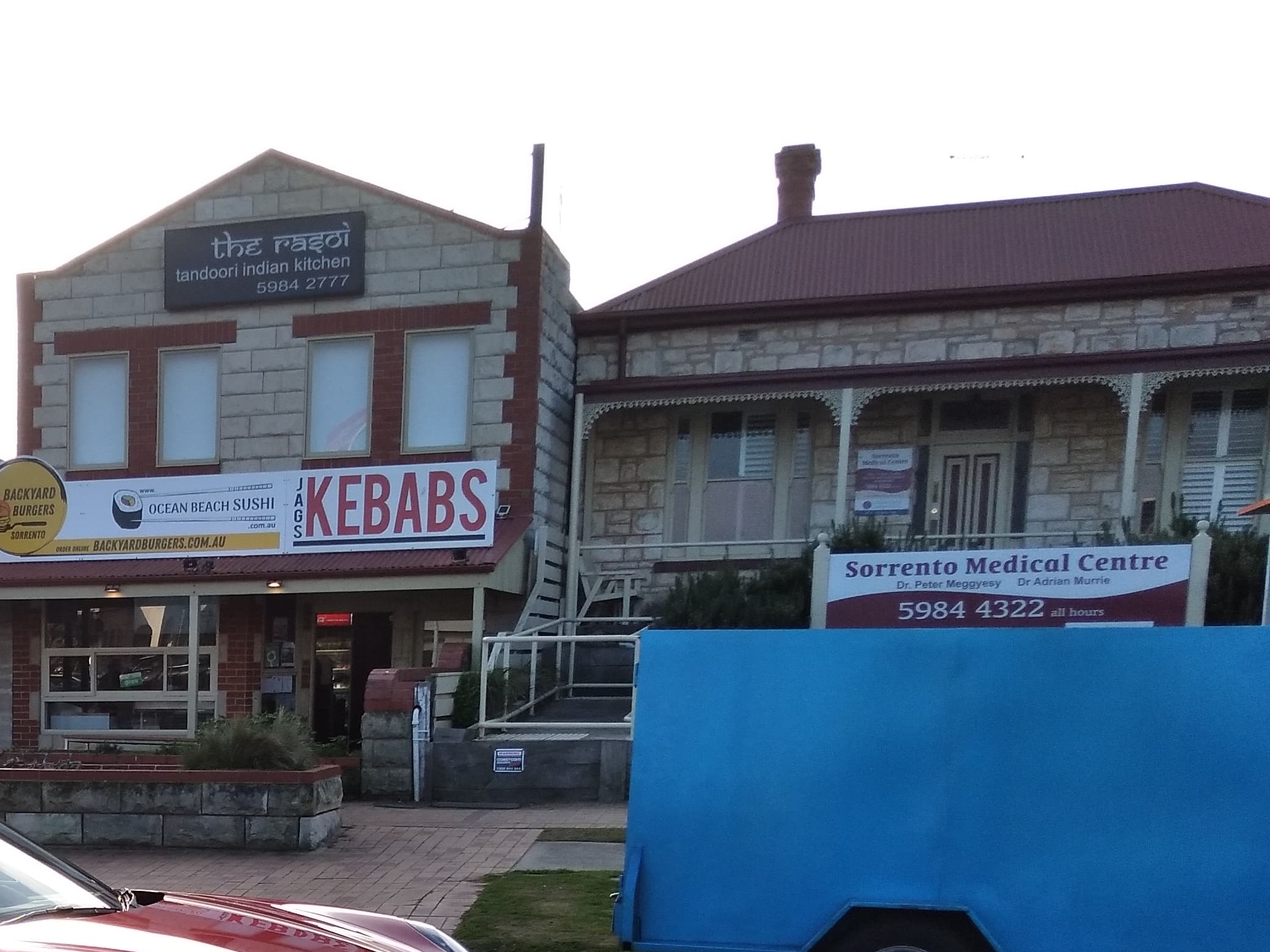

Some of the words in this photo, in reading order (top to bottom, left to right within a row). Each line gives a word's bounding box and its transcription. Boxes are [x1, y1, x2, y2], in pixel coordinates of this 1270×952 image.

[211, 231, 263, 259] the
[176, 264, 238, 283] tandoori
[242, 260, 289, 277] indian
[295, 254, 350, 272] kitchen
[257, 279, 299, 294] 5984
[306, 275, 350, 290] 2777
[3, 487, 56, 501] BACKYARD
[305, 468, 488, 537] KEBABS
[12, 504, 55, 517] BURGERS
[148, 502, 188, 515] OCEAN
[190, 500, 229, 513] BEACH
[232, 497, 275, 512] SUSHI
[293, 477, 304, 539] JAGS
[247, 521, 276, 530] .com.au
[10, 530, 46, 540] SORRENTO
[93, 536, 226, 552] BACKYARDBURGERS.COM.AU
[845, 560, 958, 578] Sorrento
[965, 553, 1069, 575] Medical
[1078, 553, 1169, 572] Centre
[896, 580, 912, 590] Dr.
[914, 580, 943, 589] Peter
[946, 579, 1001, 590] Meggyesy
[1018, 577, 1031, 586] Dr
[1033, 577, 1070, 586] Adrian
[1074, 576, 1110, 586] Murrie
[898, 601, 965, 620] 5984
[975, 599, 1044, 619] 4322
[1050, 607, 1066, 617] all
[1069, 607, 1105, 617] hours
